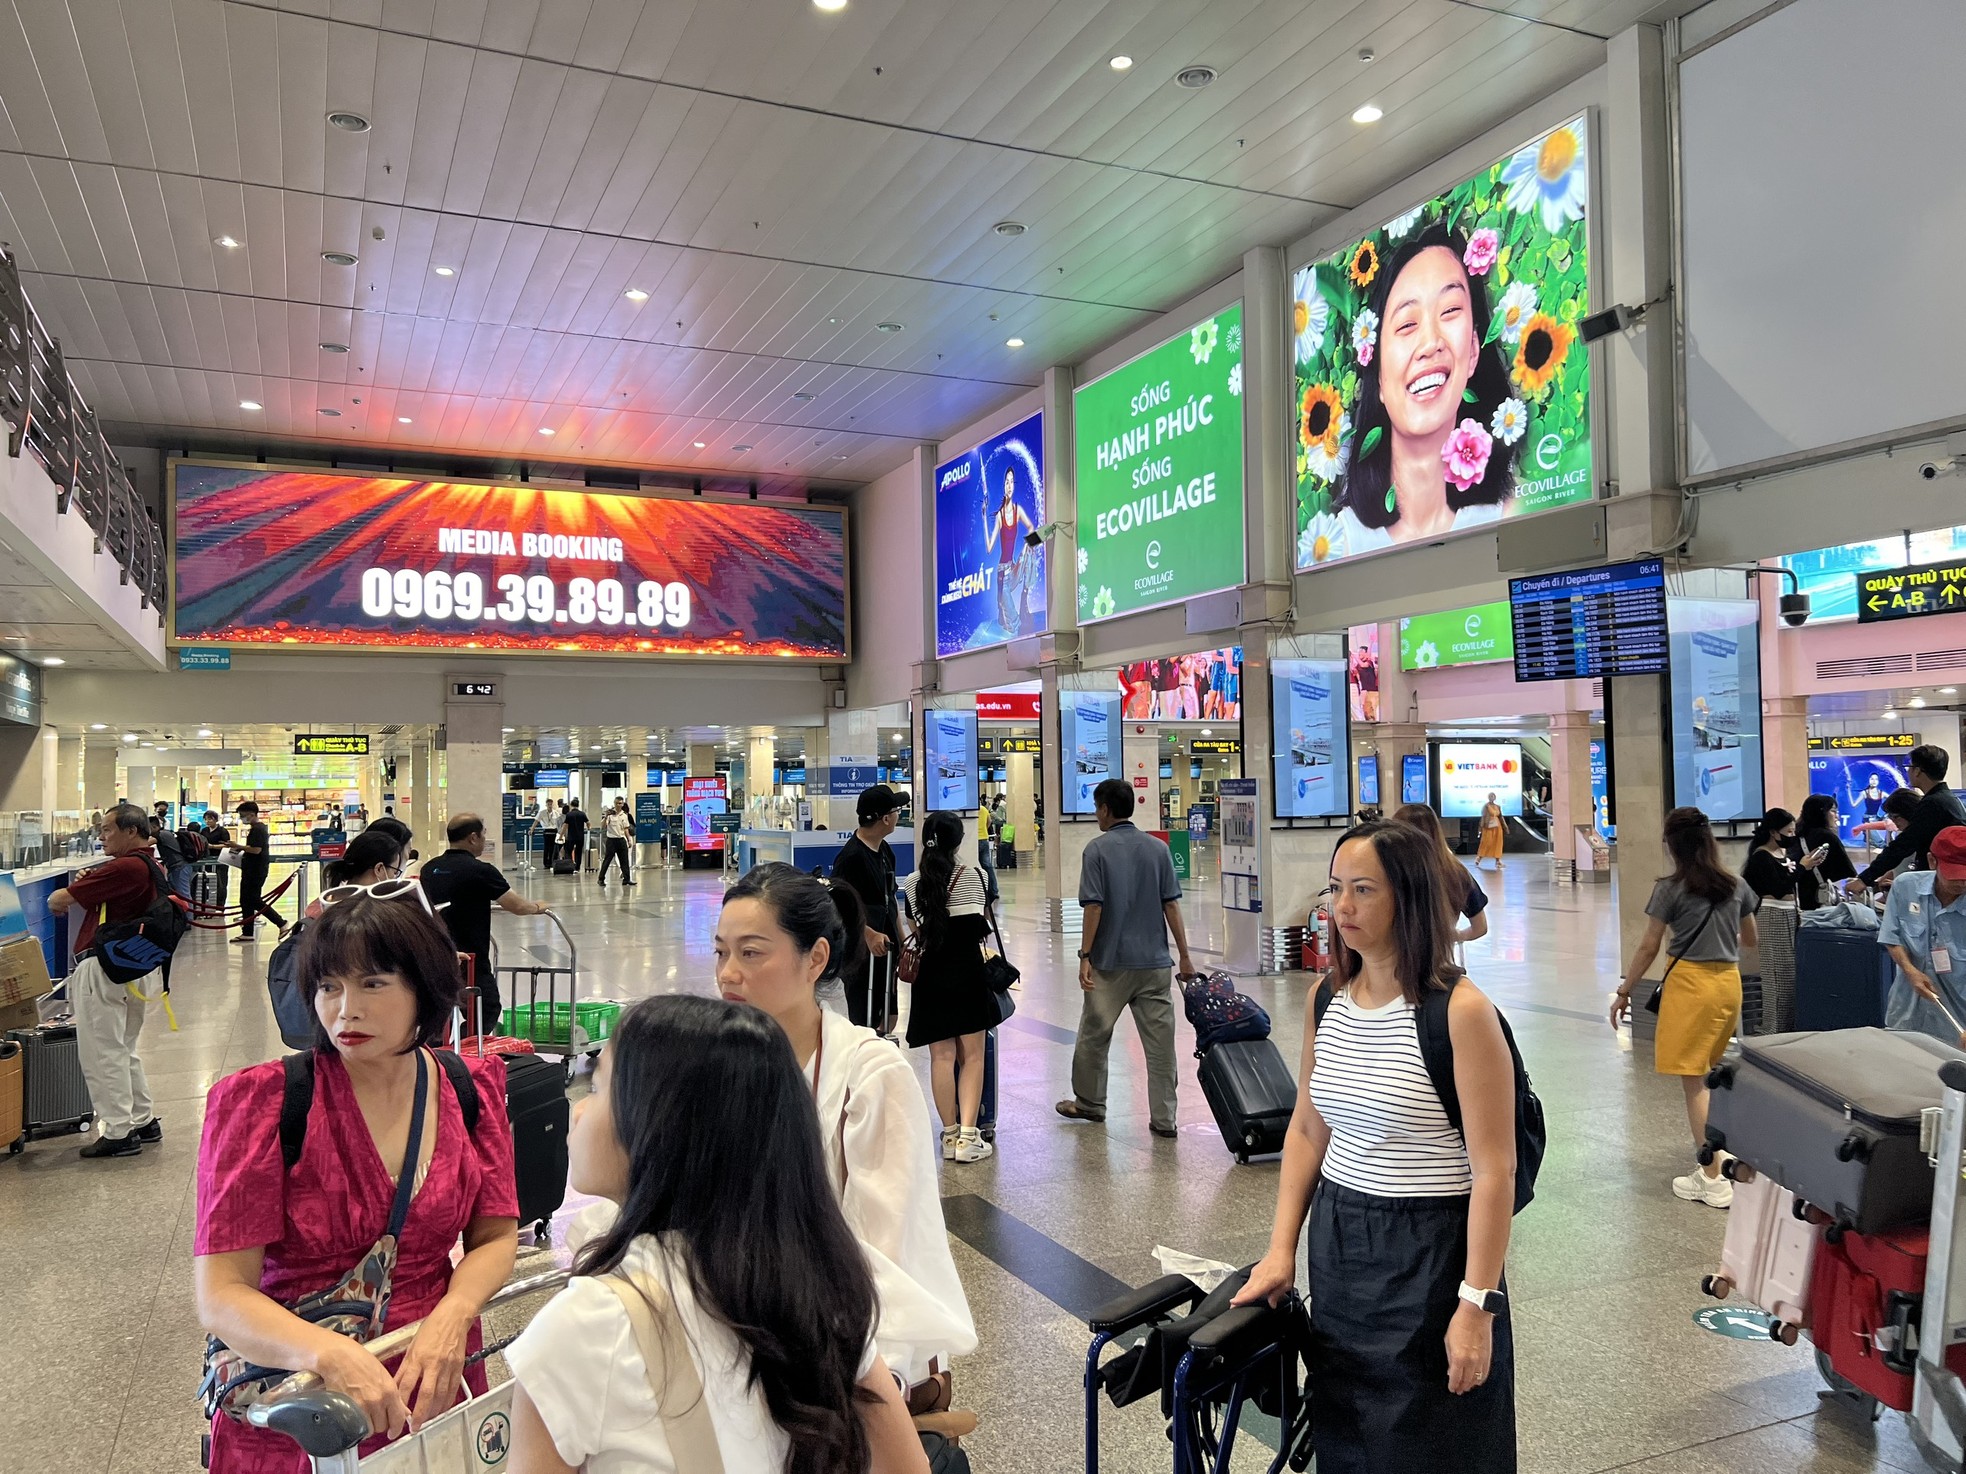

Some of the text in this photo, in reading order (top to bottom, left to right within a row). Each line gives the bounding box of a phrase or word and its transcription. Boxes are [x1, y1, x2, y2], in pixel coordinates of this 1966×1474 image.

[1131, 381, 1170, 417] SỐNG
[1096, 394, 1214, 471] HẠNH PHÚC
[941, 462, 970, 491] APOLLO
[1132, 456, 1171, 489] SỐNG
[1514, 468, 1587, 498] ECOVILLAGE
[1096, 472, 1216, 540] ECOVILLAGE
[1525, 489, 1575, 506] SAIGON RIVER
[438, 528, 623, 562] MEDIA BOOKING
[963, 562, 994, 597] CHẤT
[1134, 569, 1174, 590] ECOVILLAGE
[1551, 577, 1560, 587] đi
[1566, 572, 1610, 585] Departures
[1640, 564, 1659, 575] 06:41
[1907, 569, 1937, 585] THỦ
[361, 567, 691, 628] 0969.39.89.89
[1891, 591, 1925, 608] A-B
[1452, 639, 1495, 653] ECOVILLAGE
[346, 743, 367, 752] A-B
[1888, 735, 1913, 746] 1-25
[116, 934, 171, 968] NIKE
